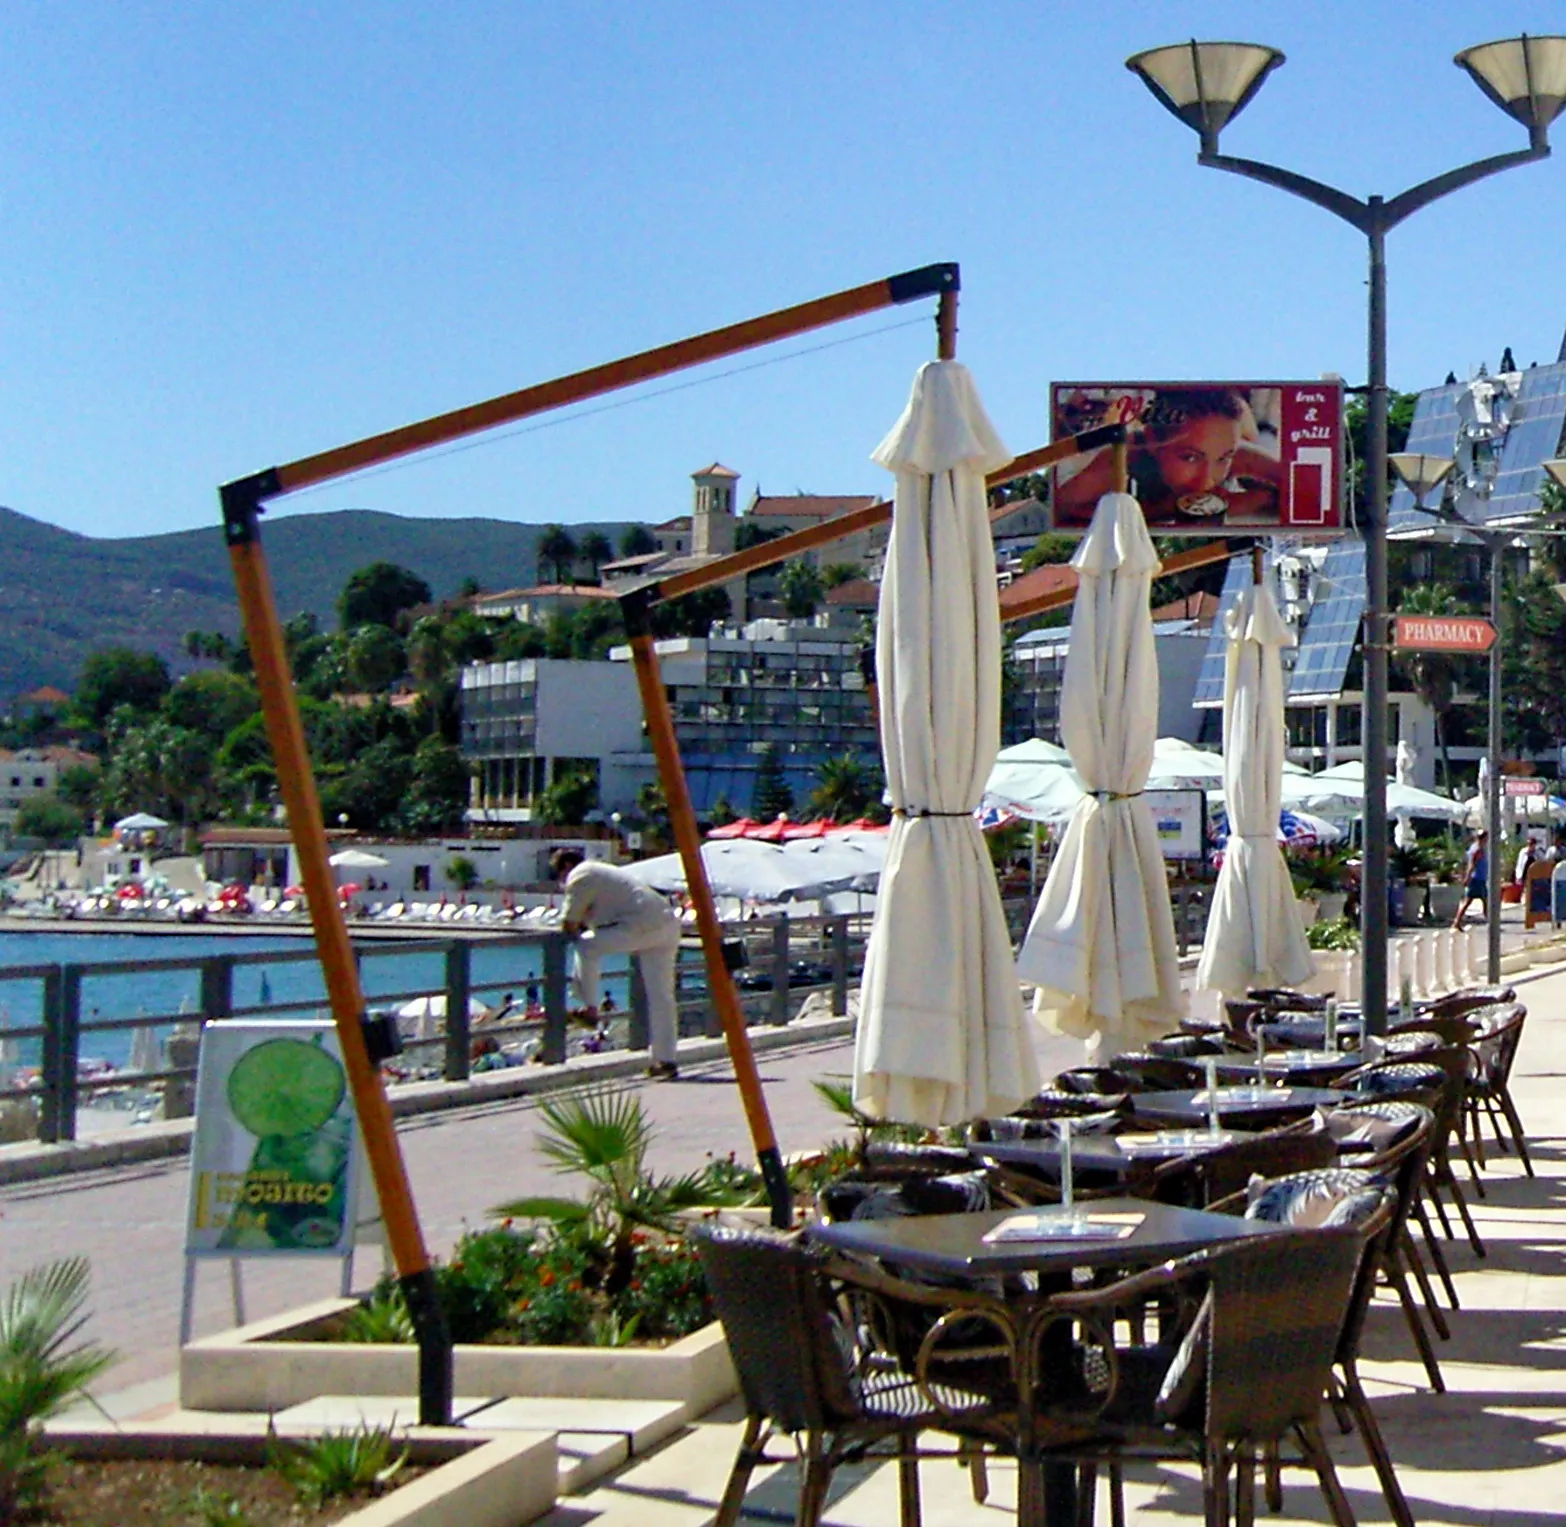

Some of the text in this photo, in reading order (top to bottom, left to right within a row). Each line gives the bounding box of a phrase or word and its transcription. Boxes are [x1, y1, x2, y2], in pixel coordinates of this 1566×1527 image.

[1296, 391, 1325, 402] bar
[1304, 407, 1319, 421] &
[1290, 425, 1331, 443] grill
[1404, 622, 1484, 642] PHARMACY
